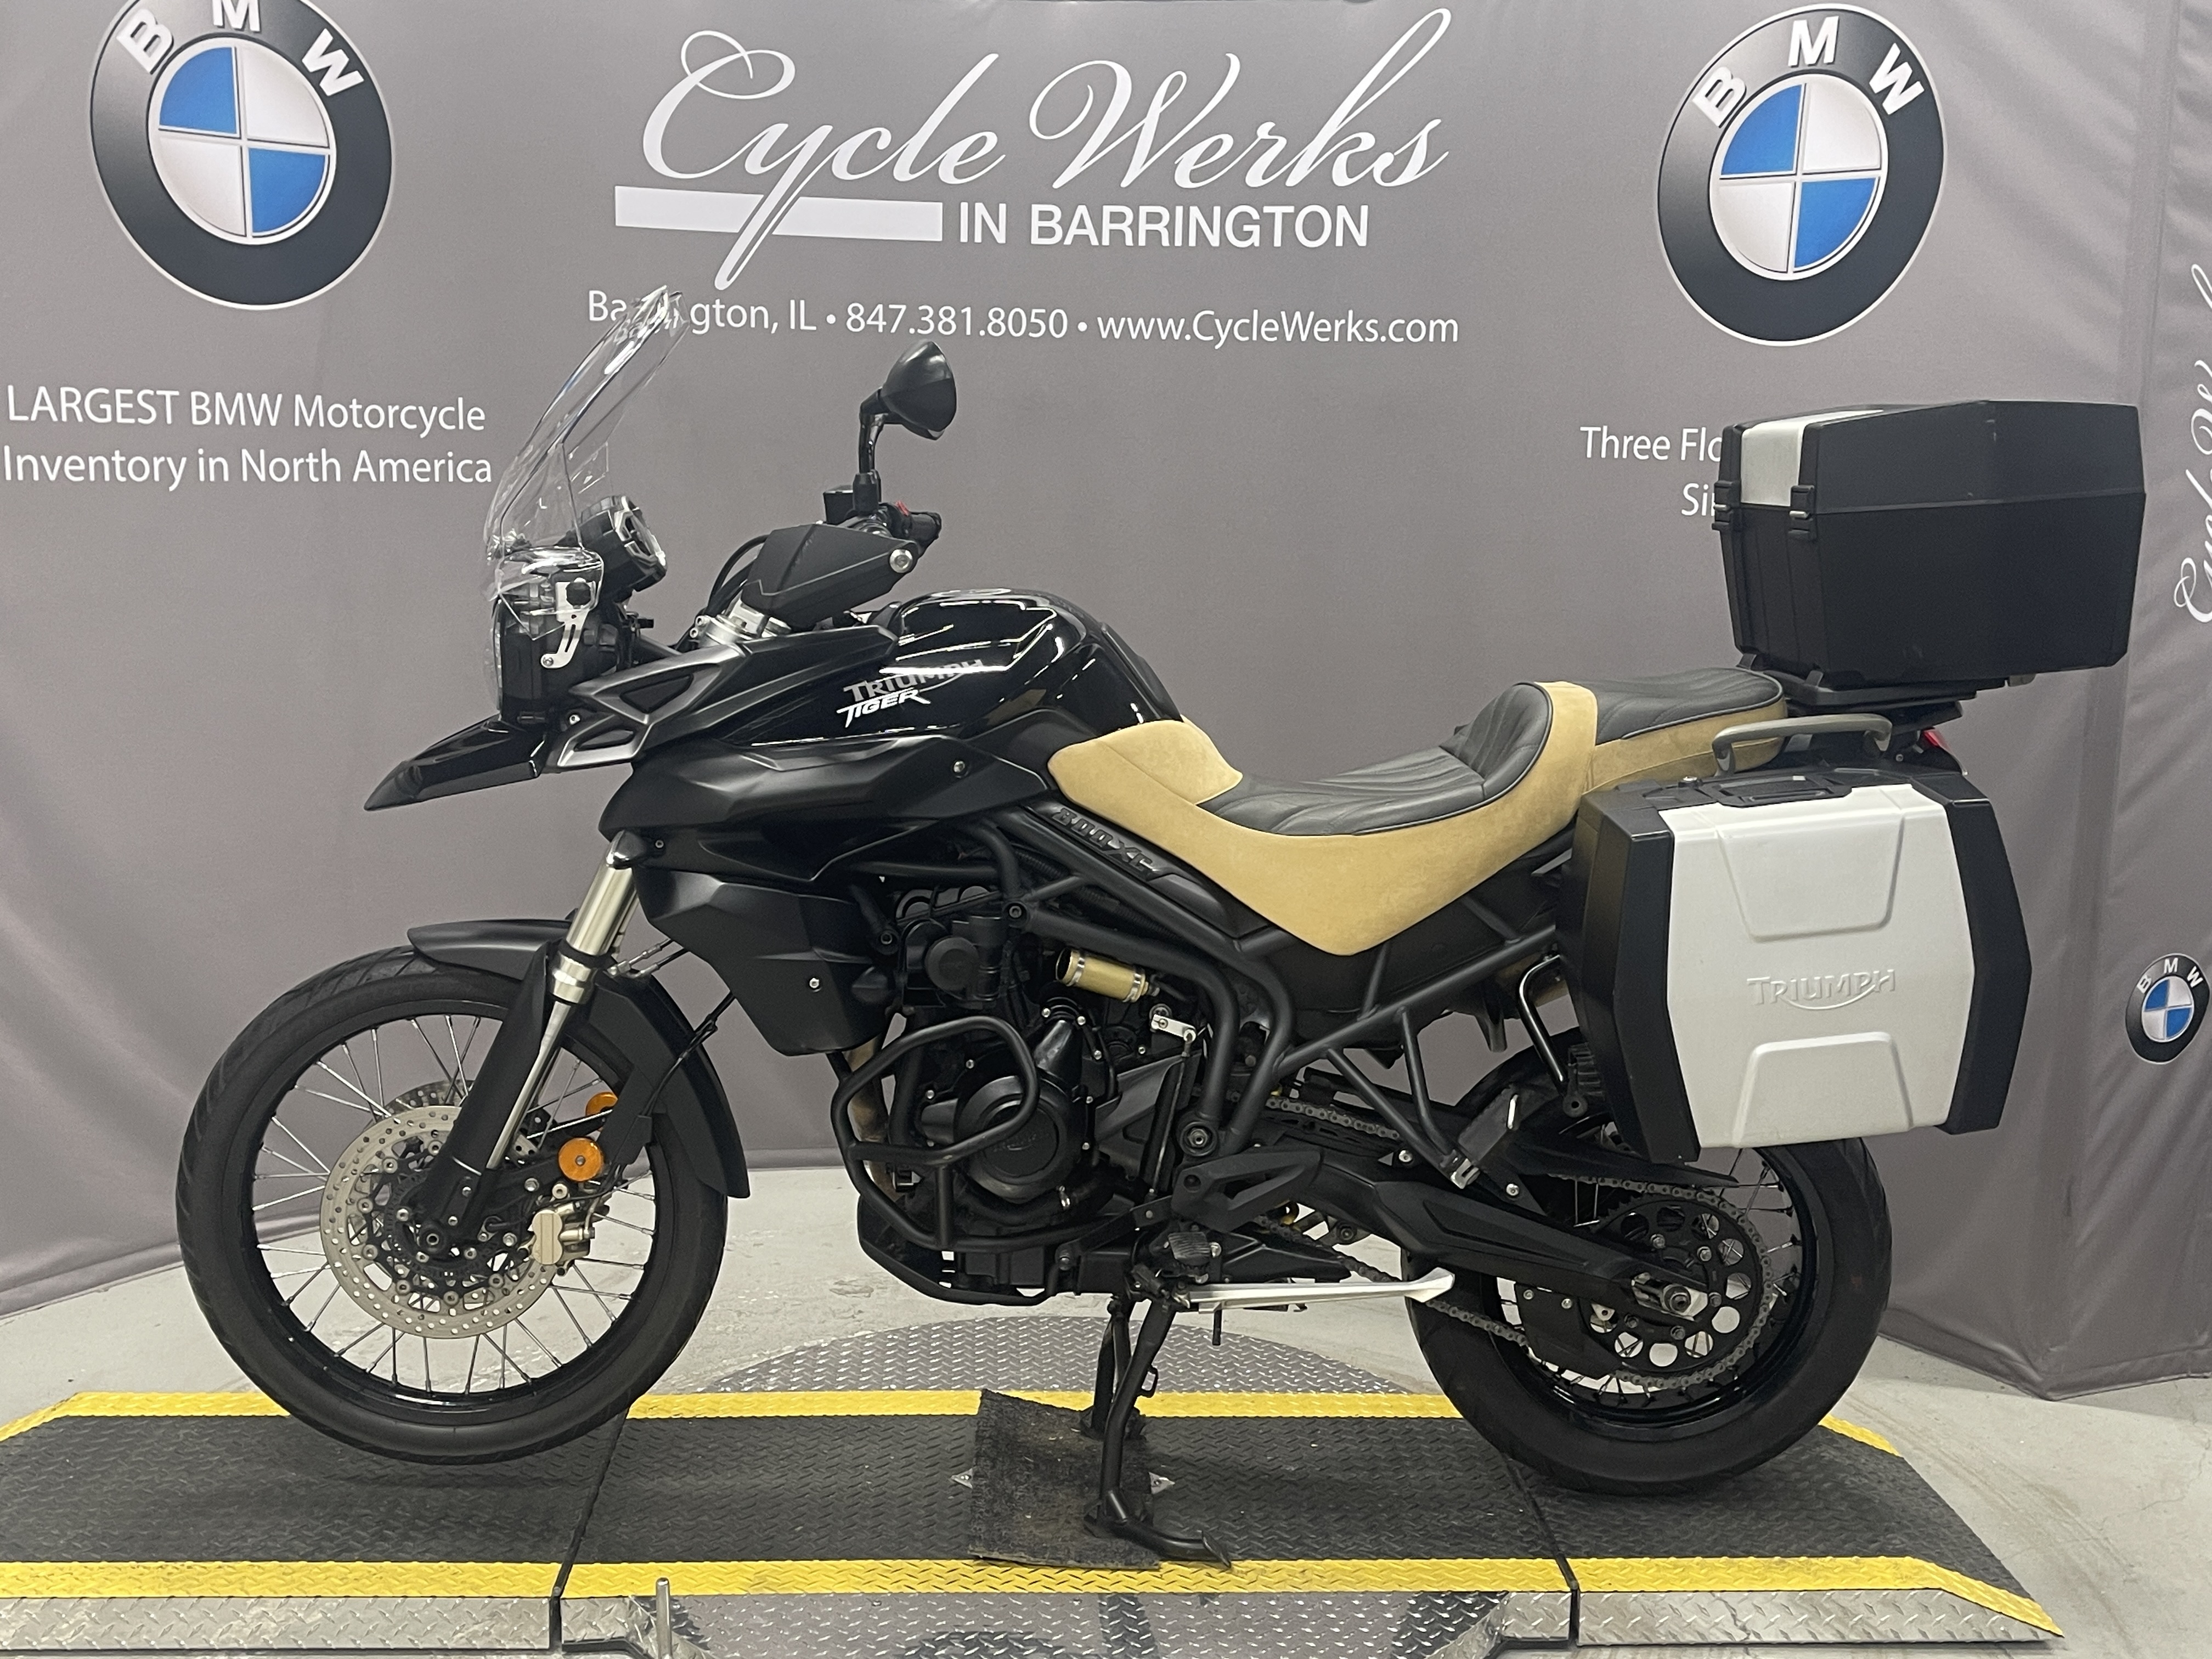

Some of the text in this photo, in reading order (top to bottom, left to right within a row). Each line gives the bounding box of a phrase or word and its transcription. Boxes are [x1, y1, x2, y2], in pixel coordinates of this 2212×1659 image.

[116, 0, 364, 97] BMW
[1692, 15, 1925, 128] BMW
[642, 7, 1452, 290] Cycle Werks
[960, 201, 1368, 248] IN BARRINGTON
[588, 290, 1458, 349] Bagton, IL 847.381.8050 www.CycleWerks.com
[8, 385, 485, 438] LARGEST BMW Motorcycle
[1580, 425, 1671, 460] Three
[3, 445, 492, 492] Inventory in North America
[837, 687, 931, 728] TIGER
[1746, 969, 1895, 1011] TRIUMPH
[2136, 957, 2204, 994] BMW
